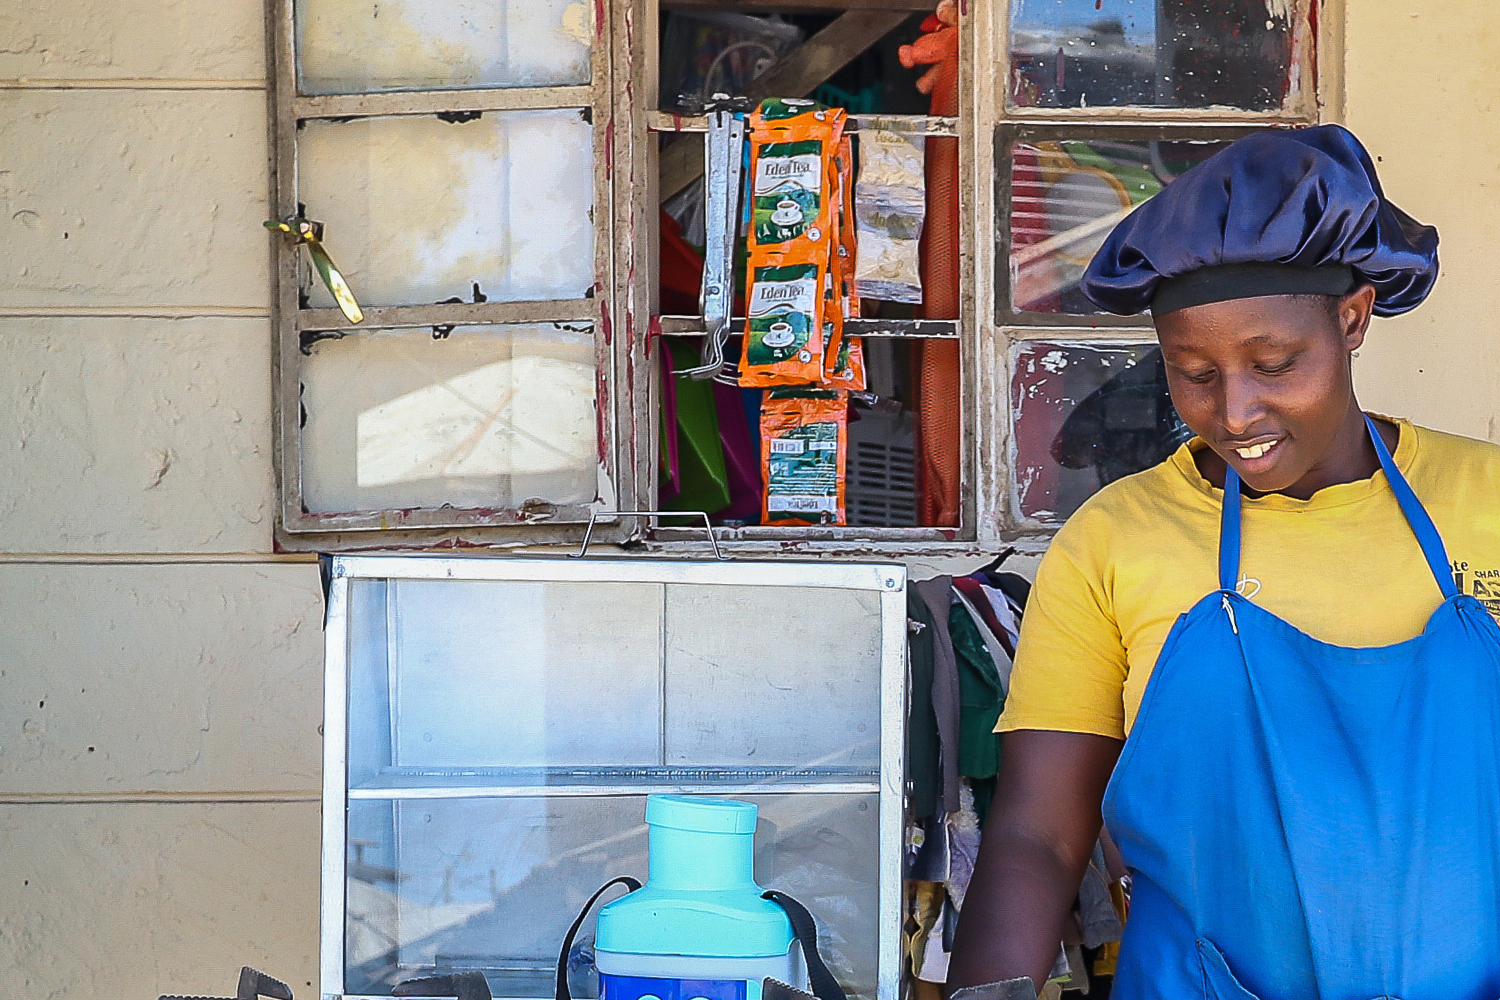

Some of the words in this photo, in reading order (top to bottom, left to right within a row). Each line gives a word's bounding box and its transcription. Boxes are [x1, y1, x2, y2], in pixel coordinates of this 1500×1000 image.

[764, 162, 791, 176] Eden
[792, 161, 811, 174] Tea
[760, 286, 787, 300] Eden
